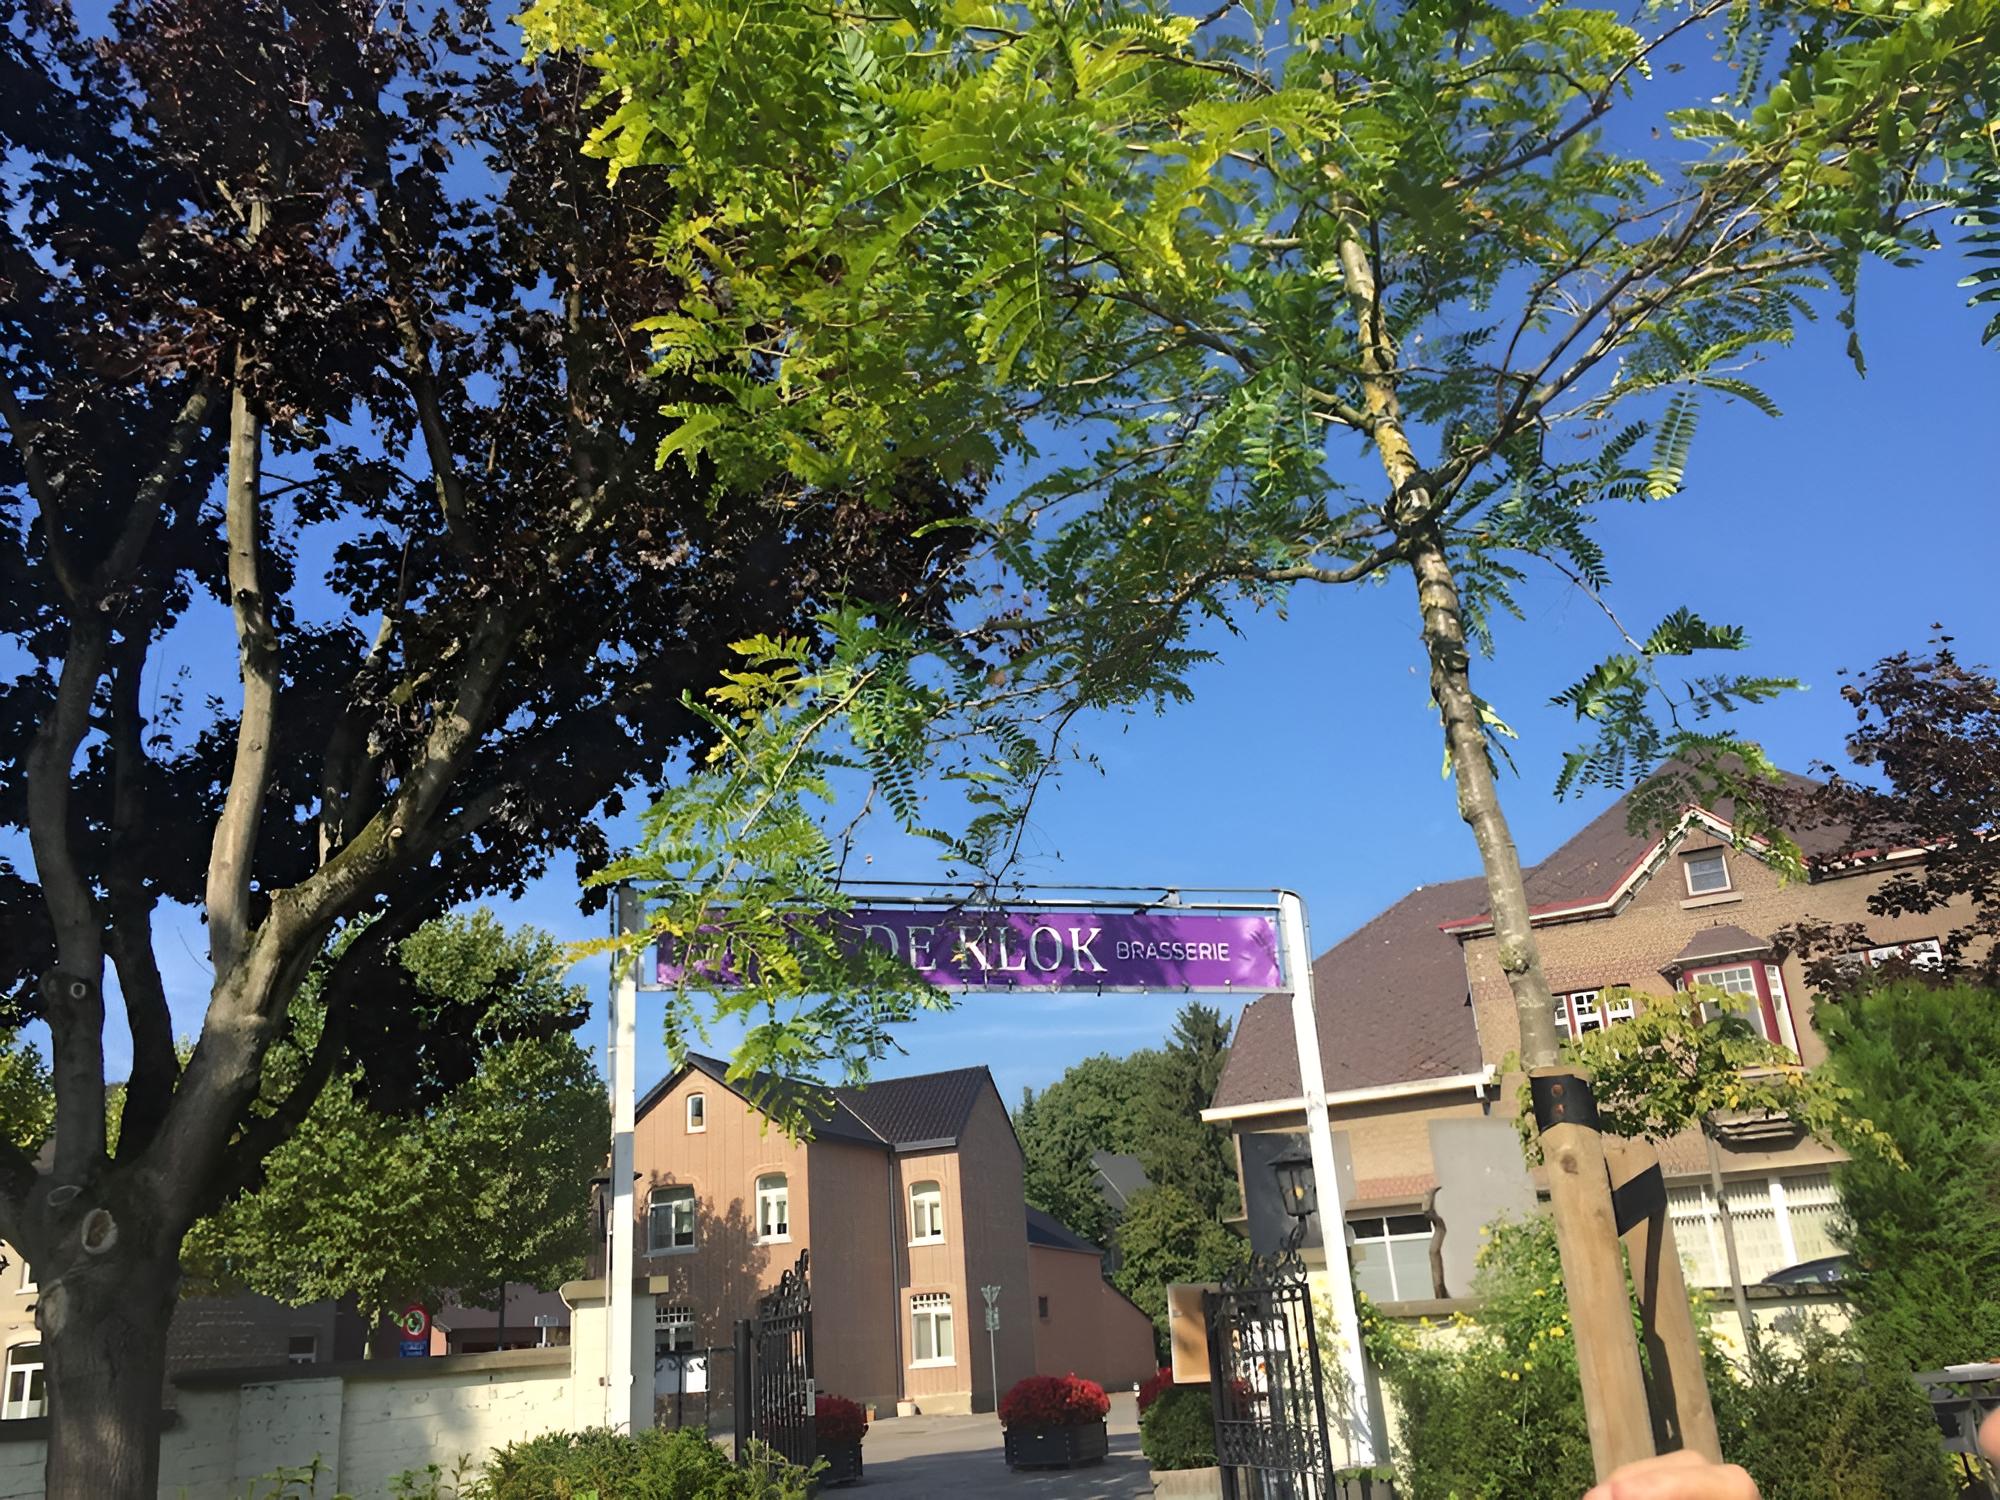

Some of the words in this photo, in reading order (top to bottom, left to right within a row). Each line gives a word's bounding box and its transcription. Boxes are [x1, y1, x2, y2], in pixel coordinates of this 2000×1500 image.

[862, 924, 937, 971] DE
[957, 925, 1108, 972] KLOK
[1115, 940, 1231, 961] BRASSERIE
